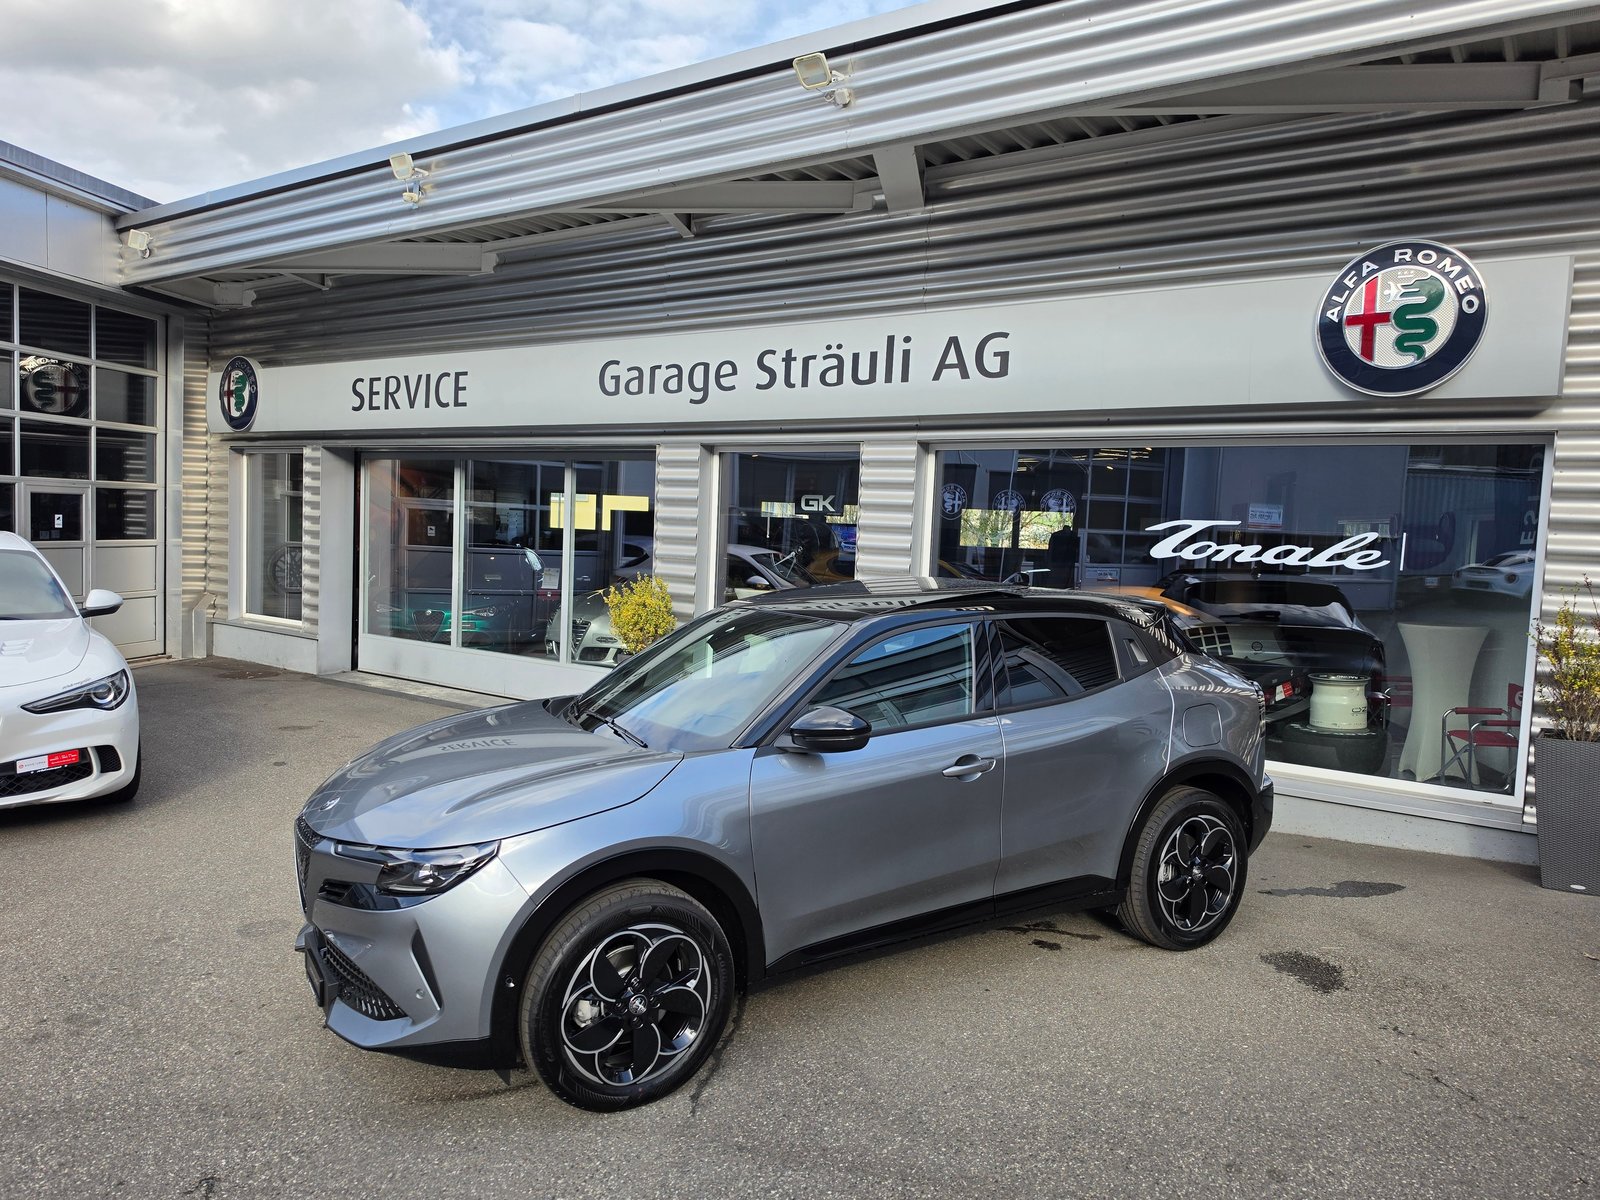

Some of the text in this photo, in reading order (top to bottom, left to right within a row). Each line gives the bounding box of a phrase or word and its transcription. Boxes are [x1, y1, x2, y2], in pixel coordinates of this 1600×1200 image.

[1326, 248, 1480, 323] ALFA ROMEO
[351, 371, 468, 411] SERVICE
[598, 331, 1010, 404] Garage Sträuli AG
[800, 494, 836, 512] GK
[1144, 519, 1391, 571] Tonale
